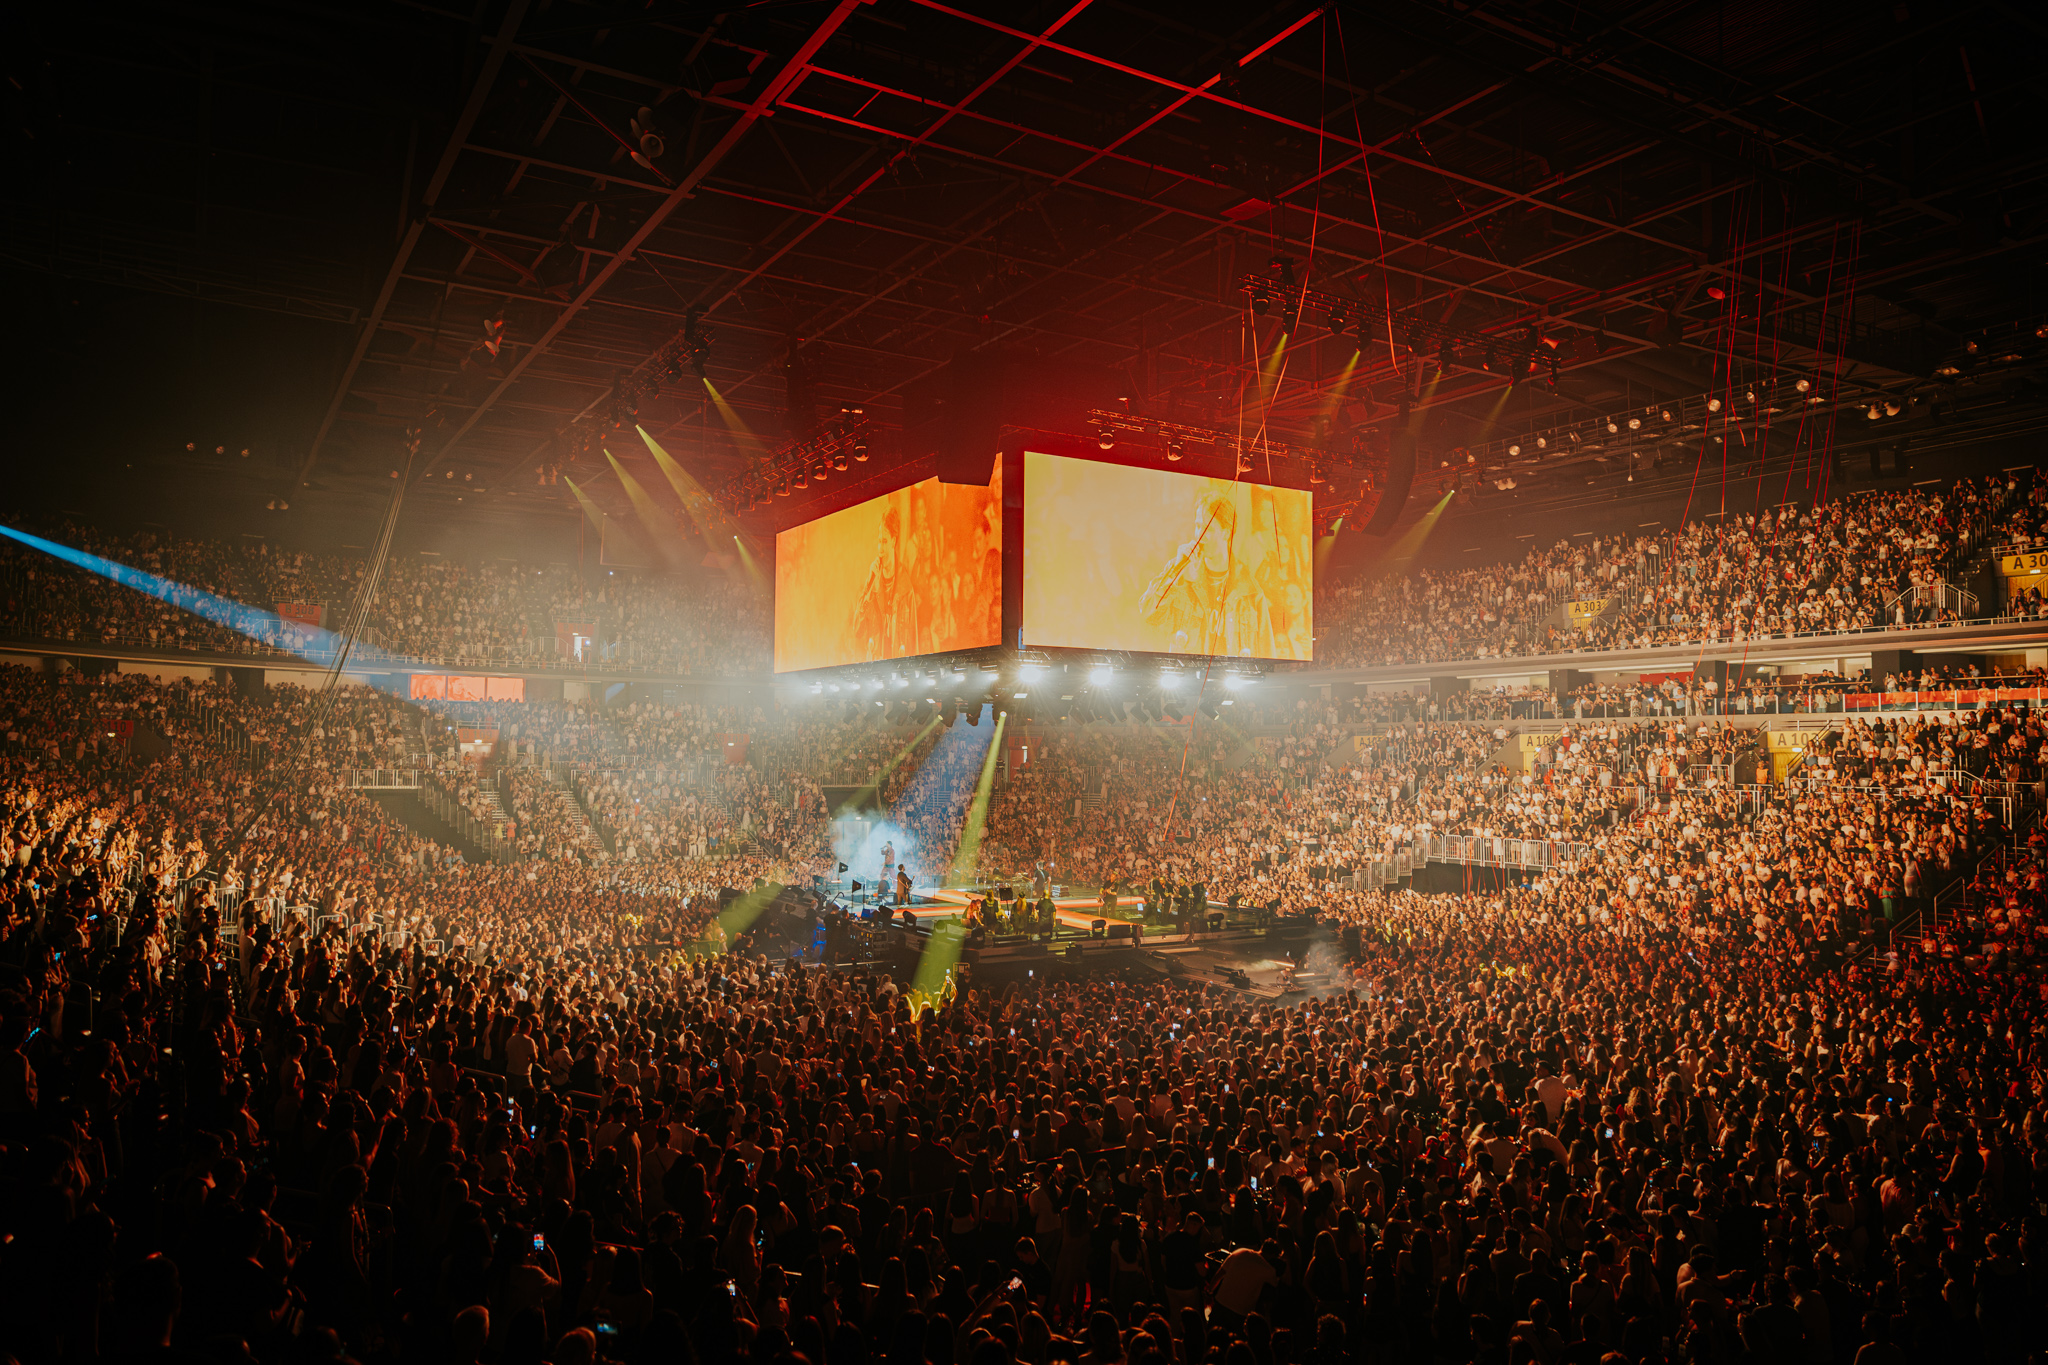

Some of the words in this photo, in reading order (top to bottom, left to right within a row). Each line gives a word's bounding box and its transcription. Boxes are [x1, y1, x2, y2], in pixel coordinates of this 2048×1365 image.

[2014, 557, 2024, 570] A
[1574, 603, 1581, 613] A
[1584, 601, 1601, 612] 303
[1527, 736, 1534, 747] A
[1778, 733, 1787, 746] A
[1791, 733, 1818, 746] 10
